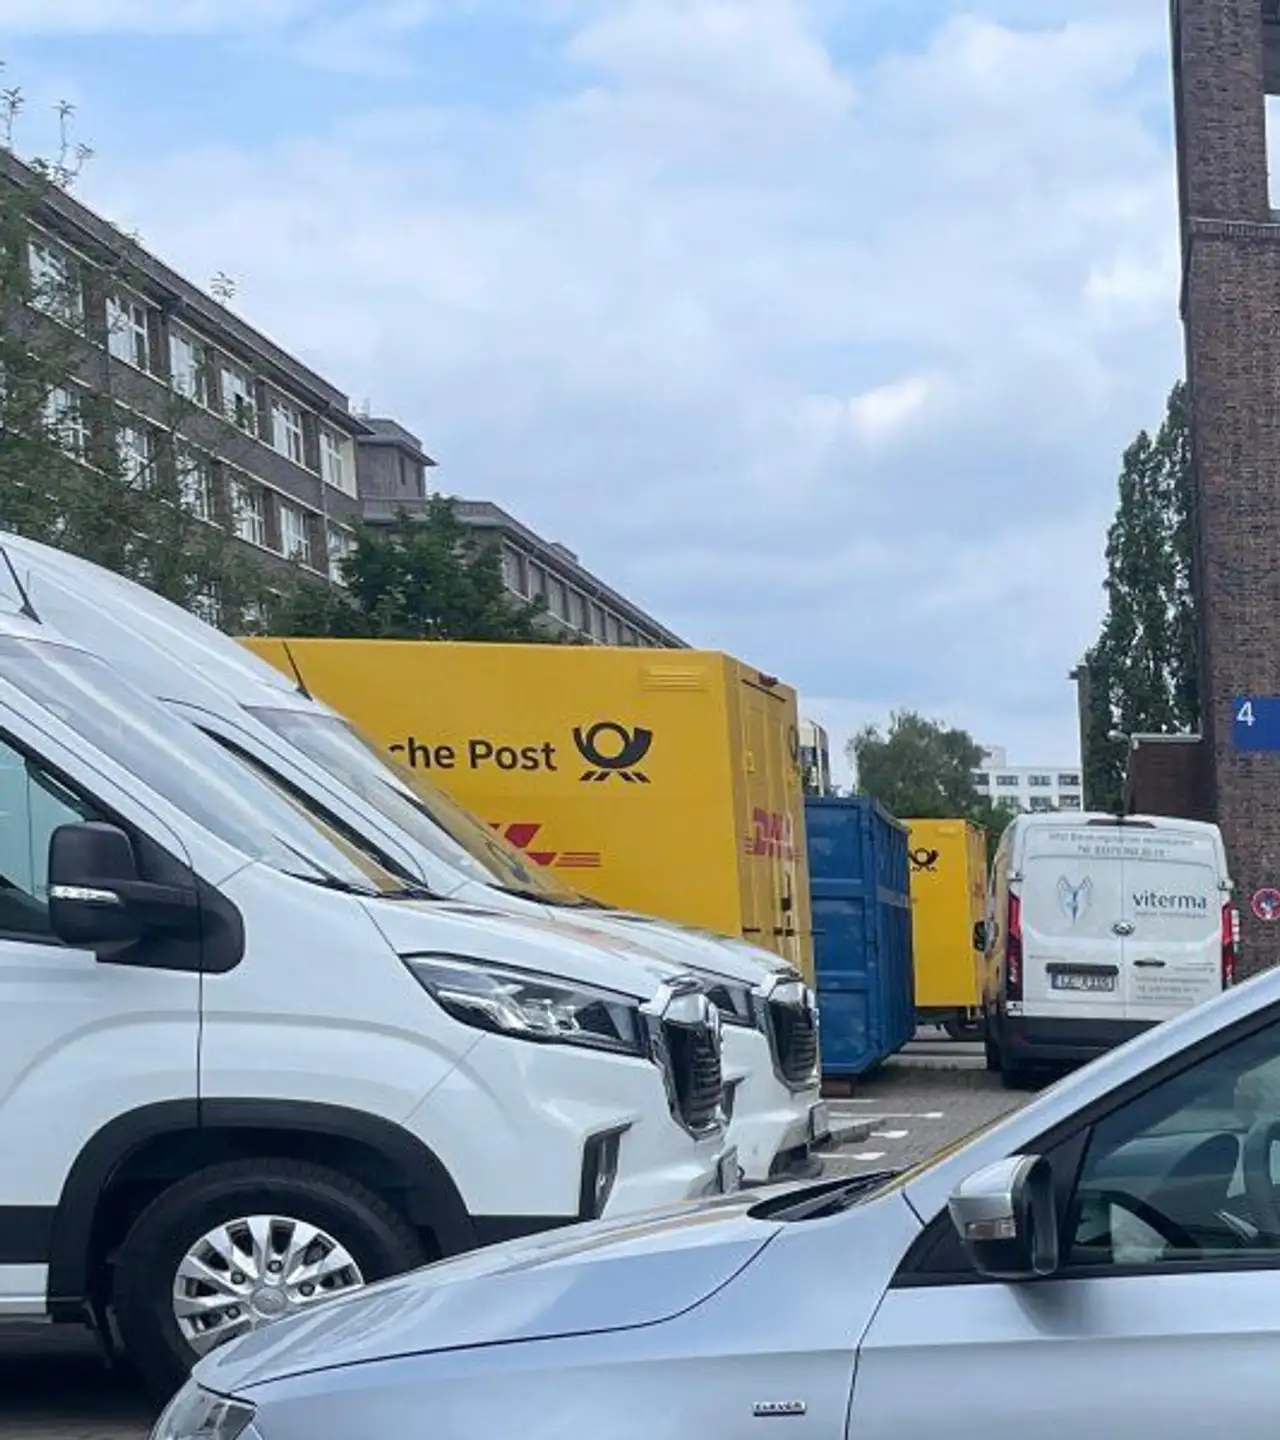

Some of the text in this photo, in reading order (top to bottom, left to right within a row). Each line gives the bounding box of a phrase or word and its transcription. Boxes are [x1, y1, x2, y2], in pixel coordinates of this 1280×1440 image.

[1236, 701, 1255, 726] 4
[468, 739, 558, 772] Post
[1132, 889, 1207, 910] viterma
